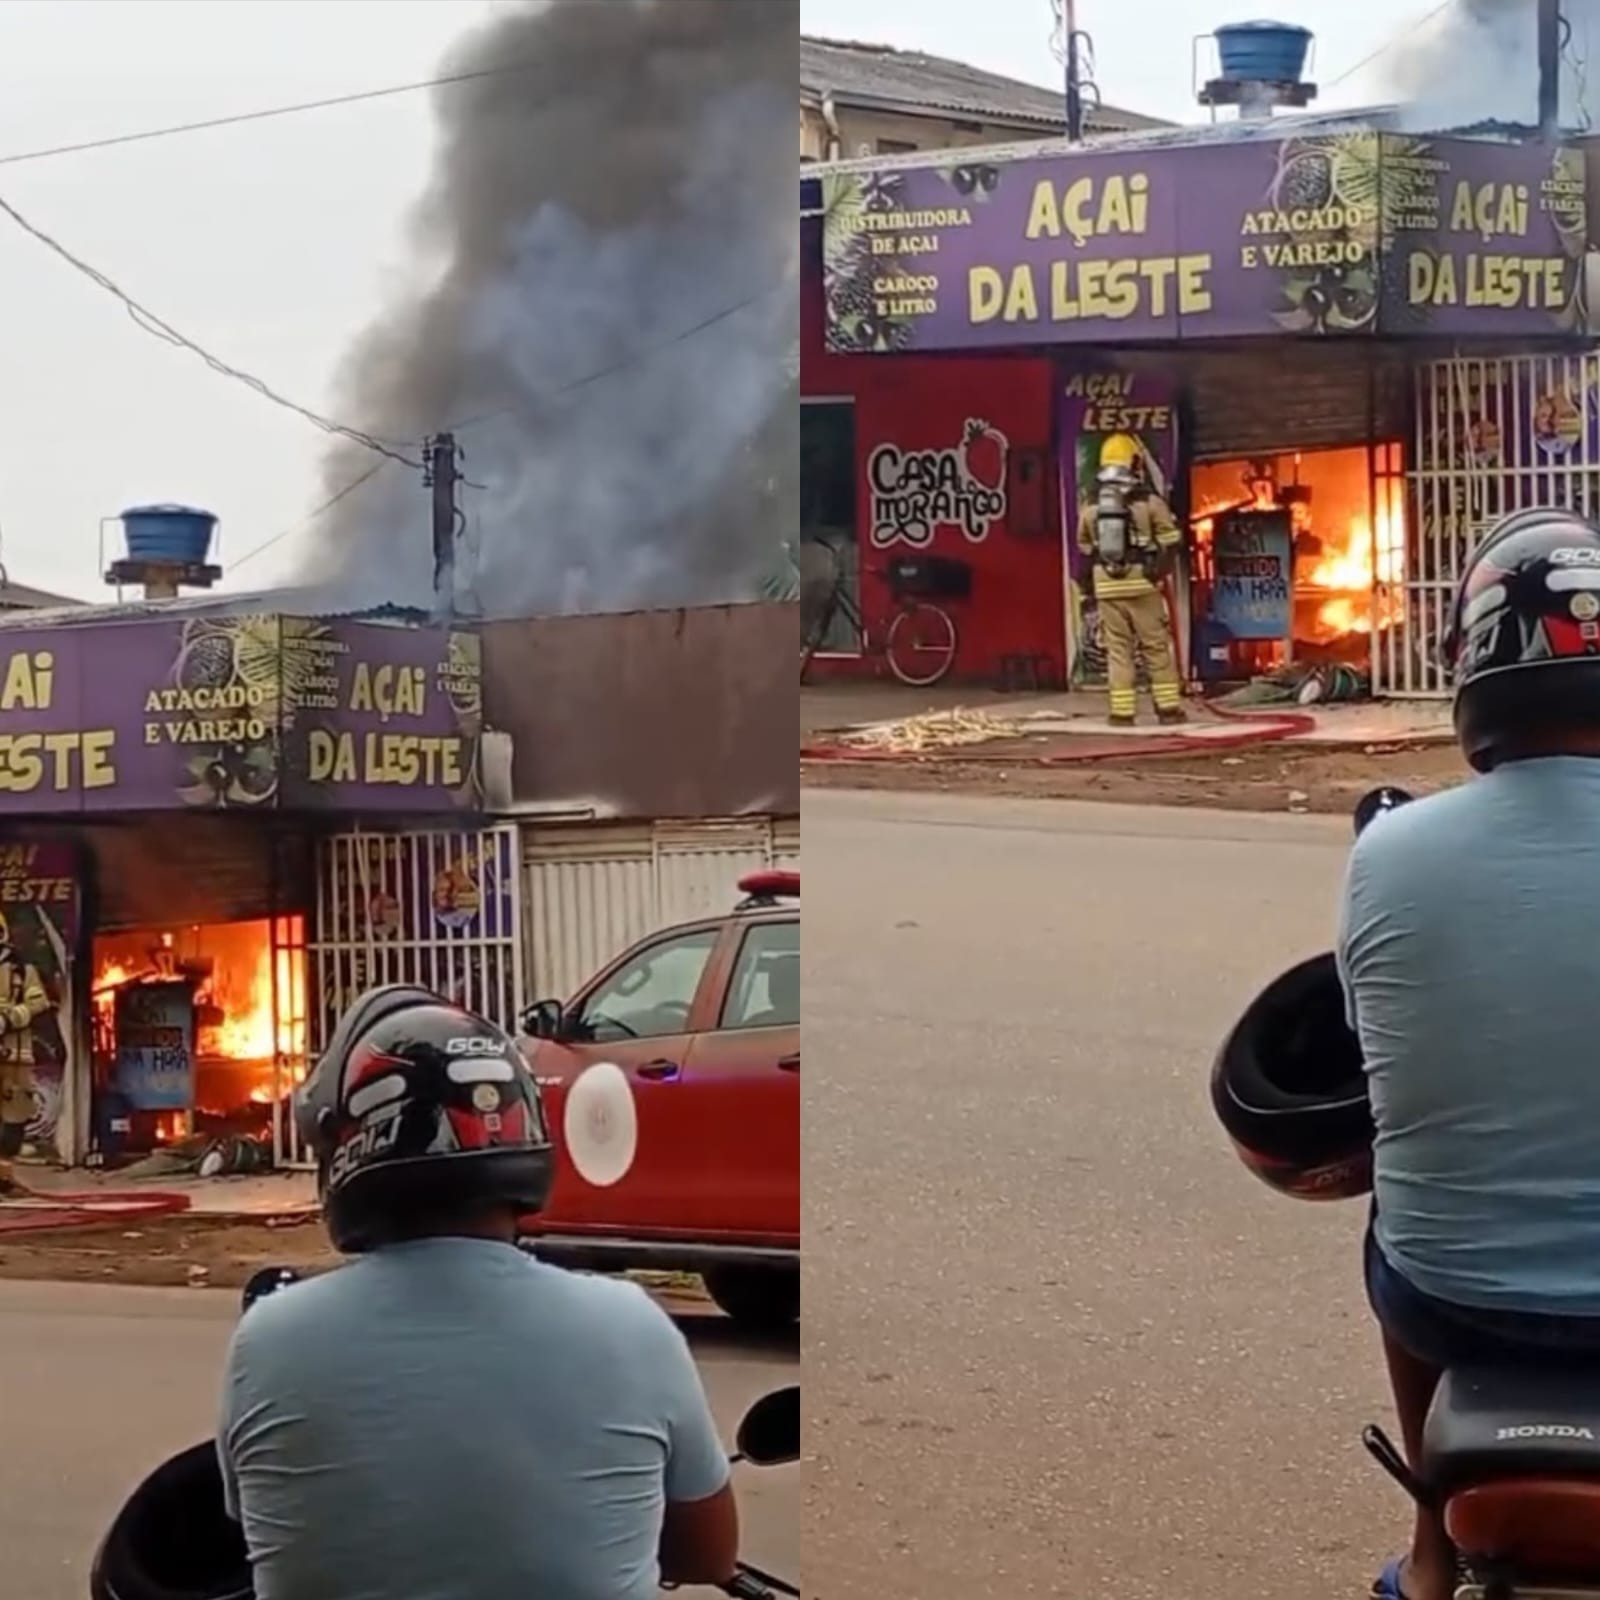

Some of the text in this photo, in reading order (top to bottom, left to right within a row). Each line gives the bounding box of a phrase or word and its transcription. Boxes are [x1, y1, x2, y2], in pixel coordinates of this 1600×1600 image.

[840, 209, 971, 230] DISTRIBUIDORA
[1242, 206, 1363, 236] ATACADO
[872, 238, 896, 254] DE
[1241, 240, 1364, 268] E VAREJO
[969, 254, 1212, 323] DA LESTE
[1410, 253, 1565, 307] DA LESTE
[876, 299, 936, 315] E LITRO
[1083, 405, 1169, 430] LESTE
[144, 686, 263, 713] ATACADO
[145, 718, 265, 744] E VAREJO
[309, 731, 462, 786] DA LESTE
[445, 1037, 507, 1054] GOW
[1496, 1424, 1594, 1440] HONDA
